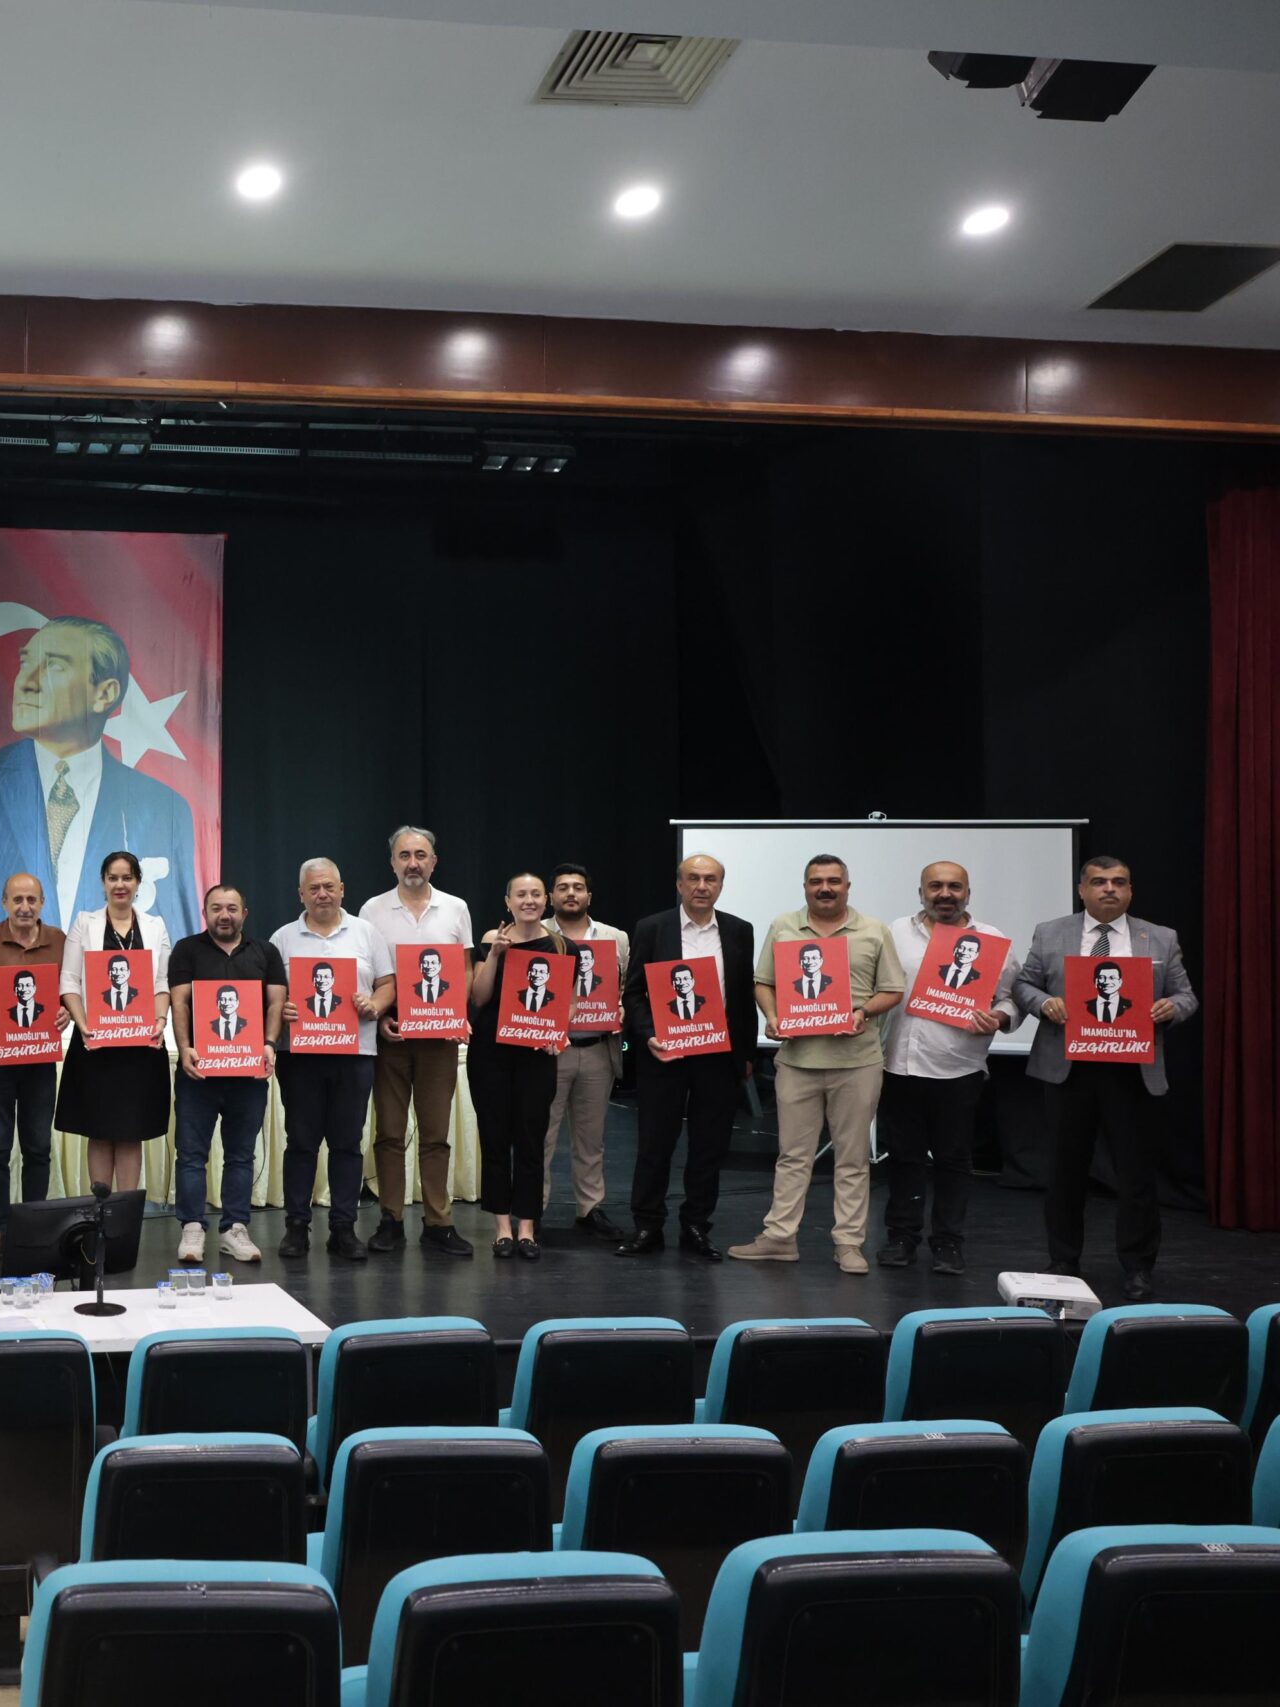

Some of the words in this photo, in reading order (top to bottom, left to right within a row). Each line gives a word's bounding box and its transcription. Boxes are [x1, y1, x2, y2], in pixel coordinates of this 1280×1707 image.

[926, 987, 975, 1006] İMAMOĞLU'NA
[411, 1008, 454, 1016] İMAMOĞLU'NA
[790, 1003, 837, 1012] İMAMOĞLU'NA
[100, 1015, 143, 1024] İMAMOĞLU'NA
[401, 1019, 464, 1032] ÖZGÜRLÜK!
[511, 1013, 555, 1027] İMAMOĞLU'NA
[780, 1012, 848, 1029] ÖZGÜRLÜK!
[302, 1021, 346, 1031] İMAMOĞLU'NA
[668, 1022, 714, 1034] İMAMOĞLU'NA
[1081, 1026, 1137, 1038] İMAMOĞLU'NA
[6, 1032, 49, 1042] İMAMOĞLU'NA
[499, 1026, 565, 1040] ÖZGÜRLÜK!
[293, 1034, 356, 1046] ÖZGÜRLÜK!
[208, 1045, 251, 1054] İMAMOĞLU'NA
[1068, 1041, 1149, 1053] ÖZGÜRLÜK!
[198, 1056, 261, 1070] ÖZGÜRLÜK!
